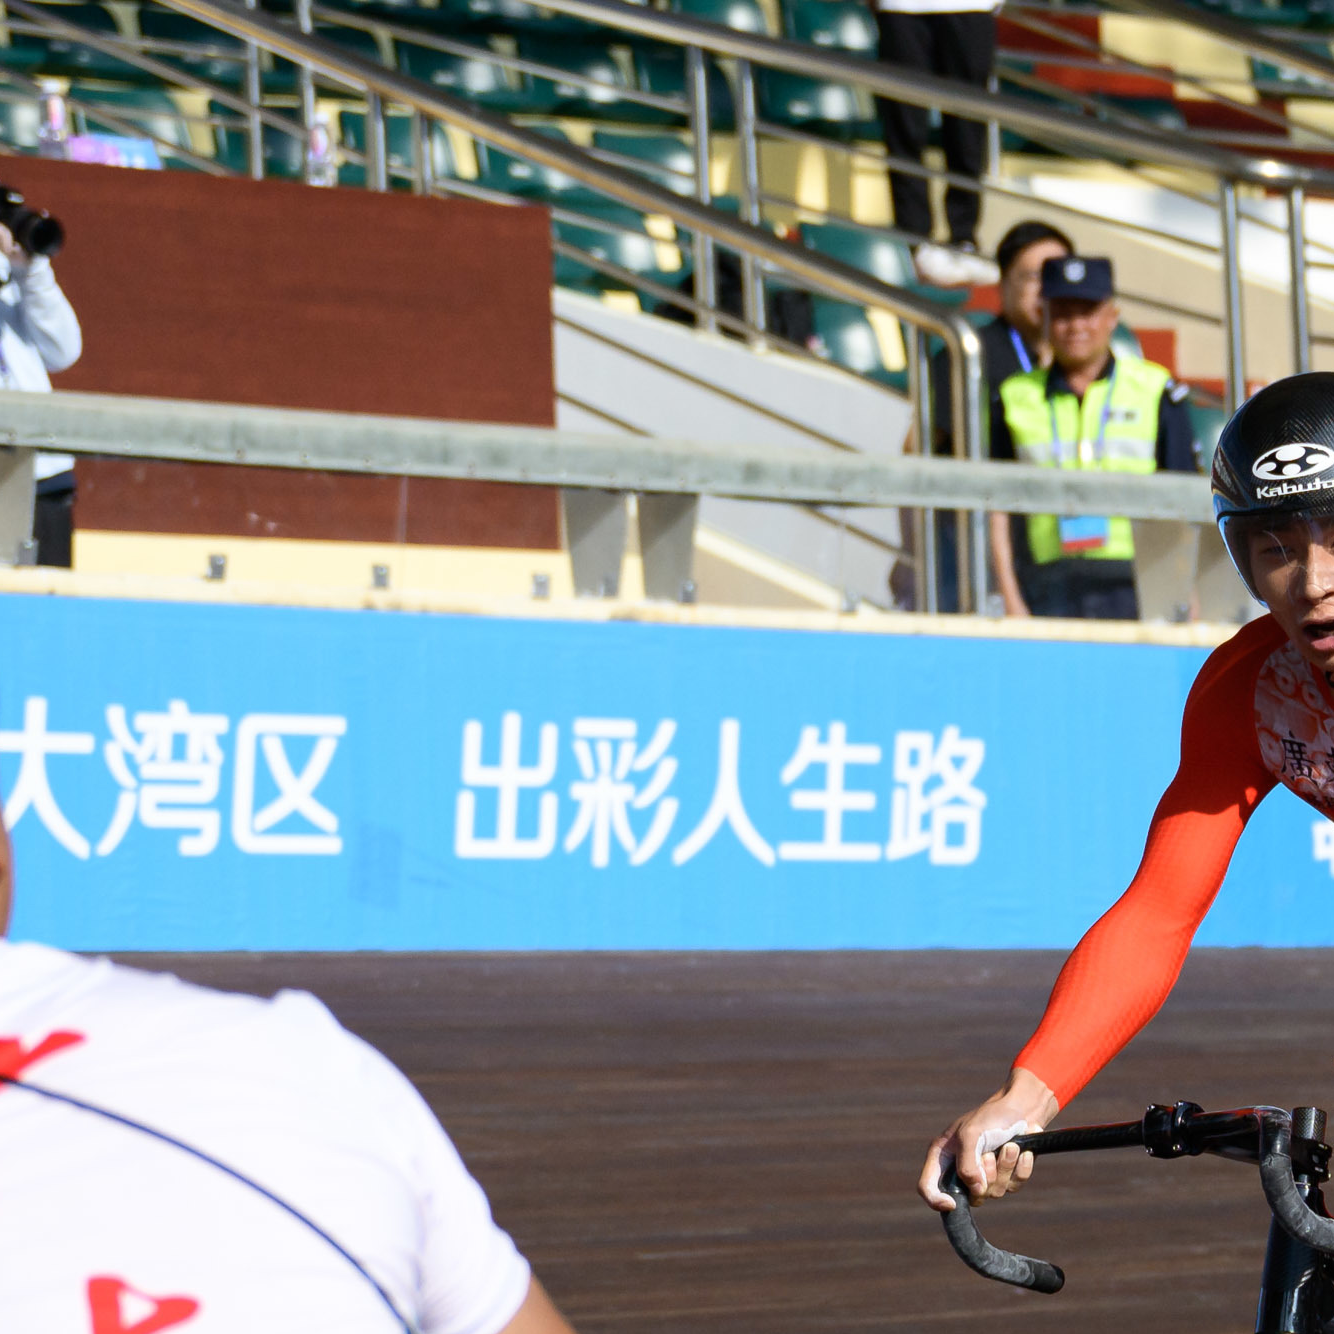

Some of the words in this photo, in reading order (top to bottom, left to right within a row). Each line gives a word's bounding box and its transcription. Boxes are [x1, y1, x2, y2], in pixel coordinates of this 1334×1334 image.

[453, 711, 988, 869] 出彩人生路
